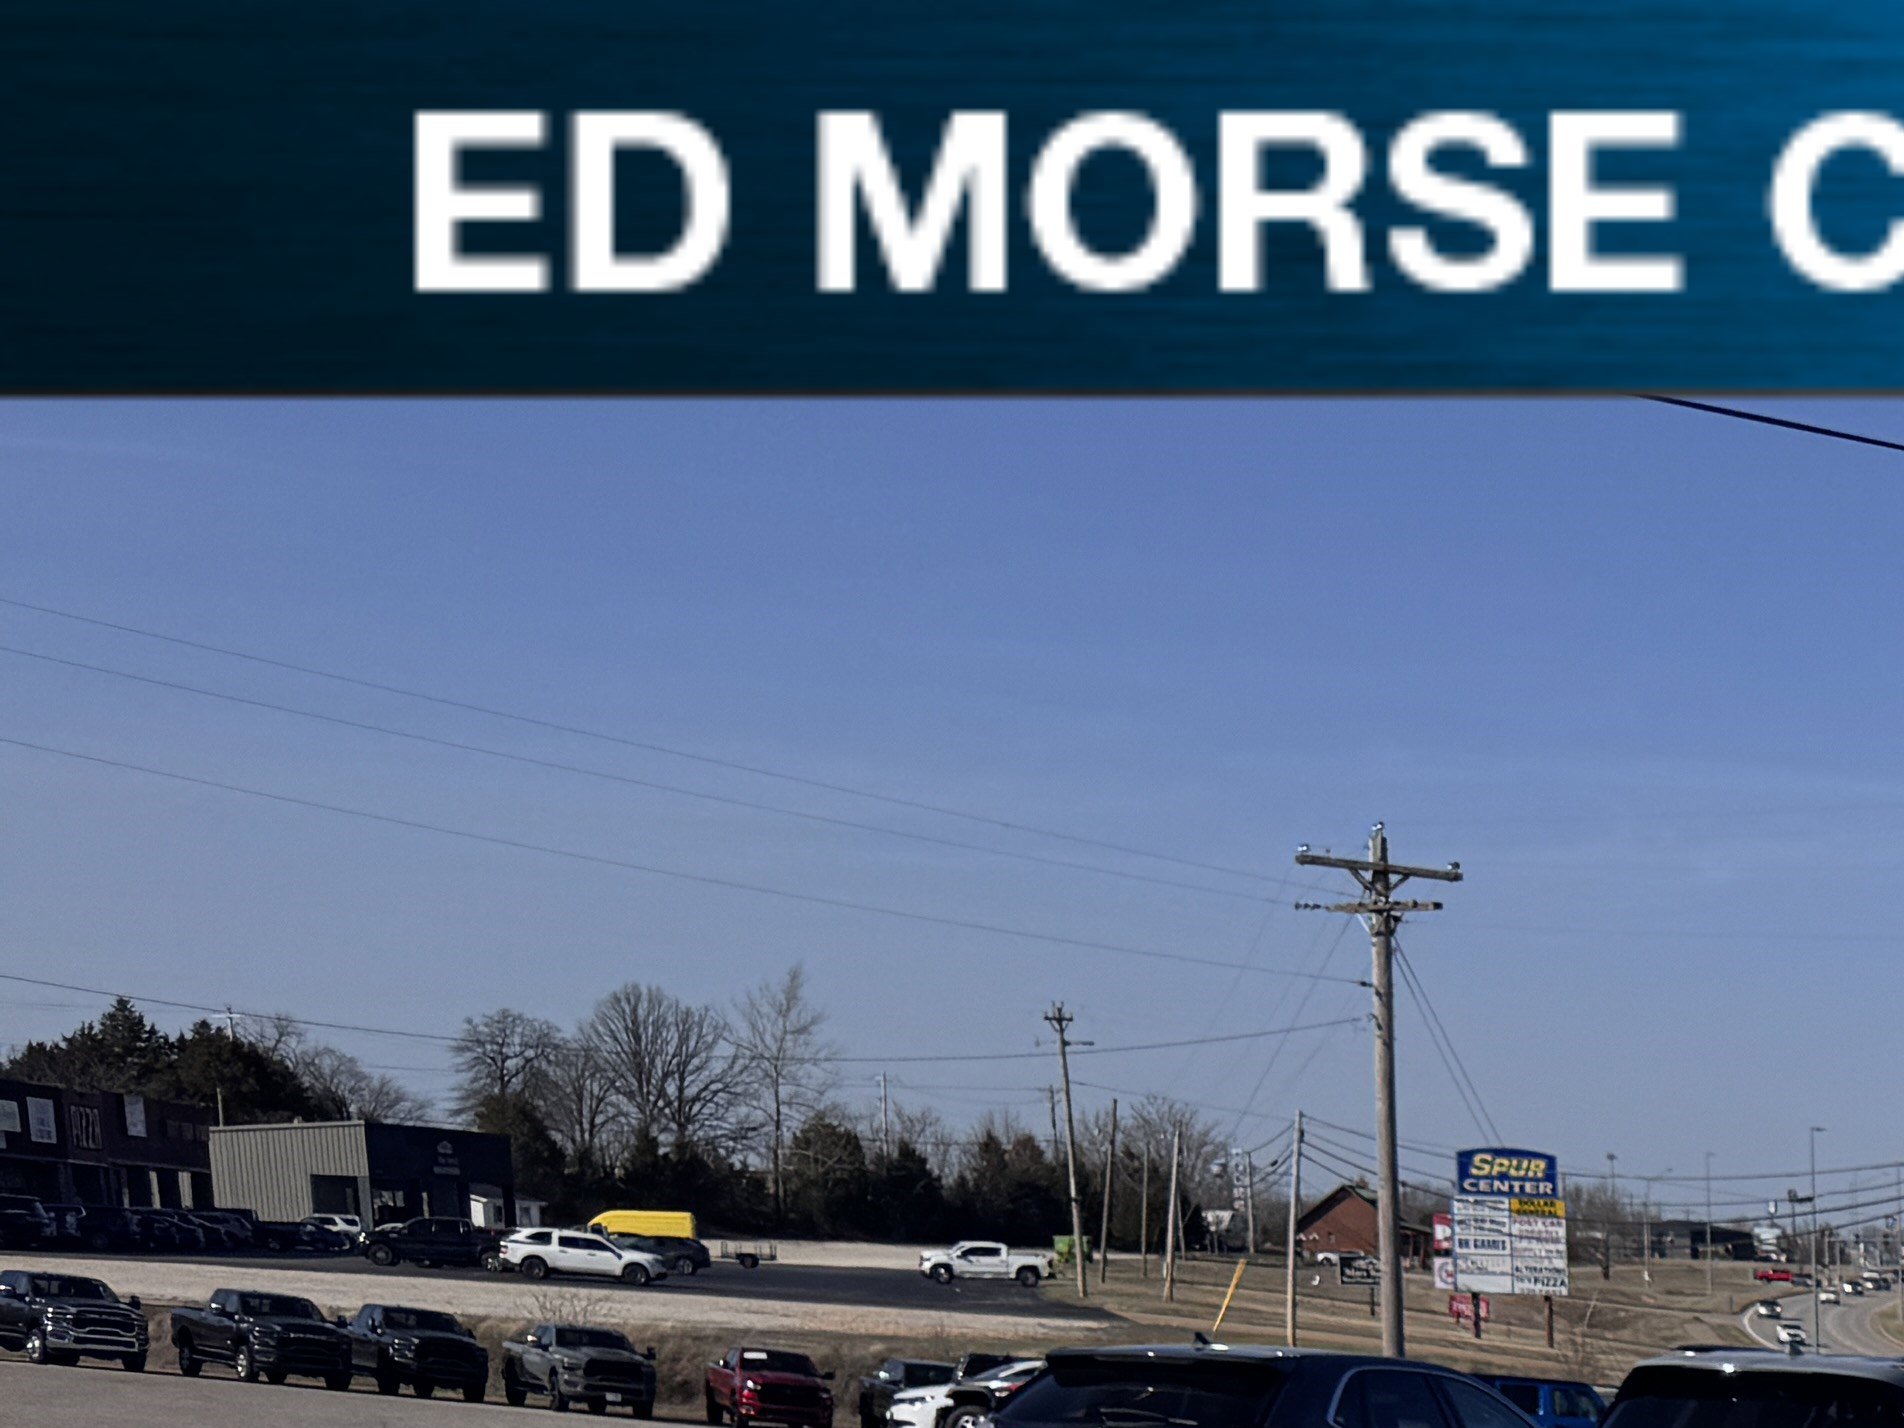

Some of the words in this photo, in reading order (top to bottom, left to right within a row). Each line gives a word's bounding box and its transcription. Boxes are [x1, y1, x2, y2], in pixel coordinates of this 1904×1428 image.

[1469, 1153, 1548, 1179] SPUR
[1462, 1179, 1554, 1195] CENTER
[1533, 1276, 1567, 1288] PIZZA
